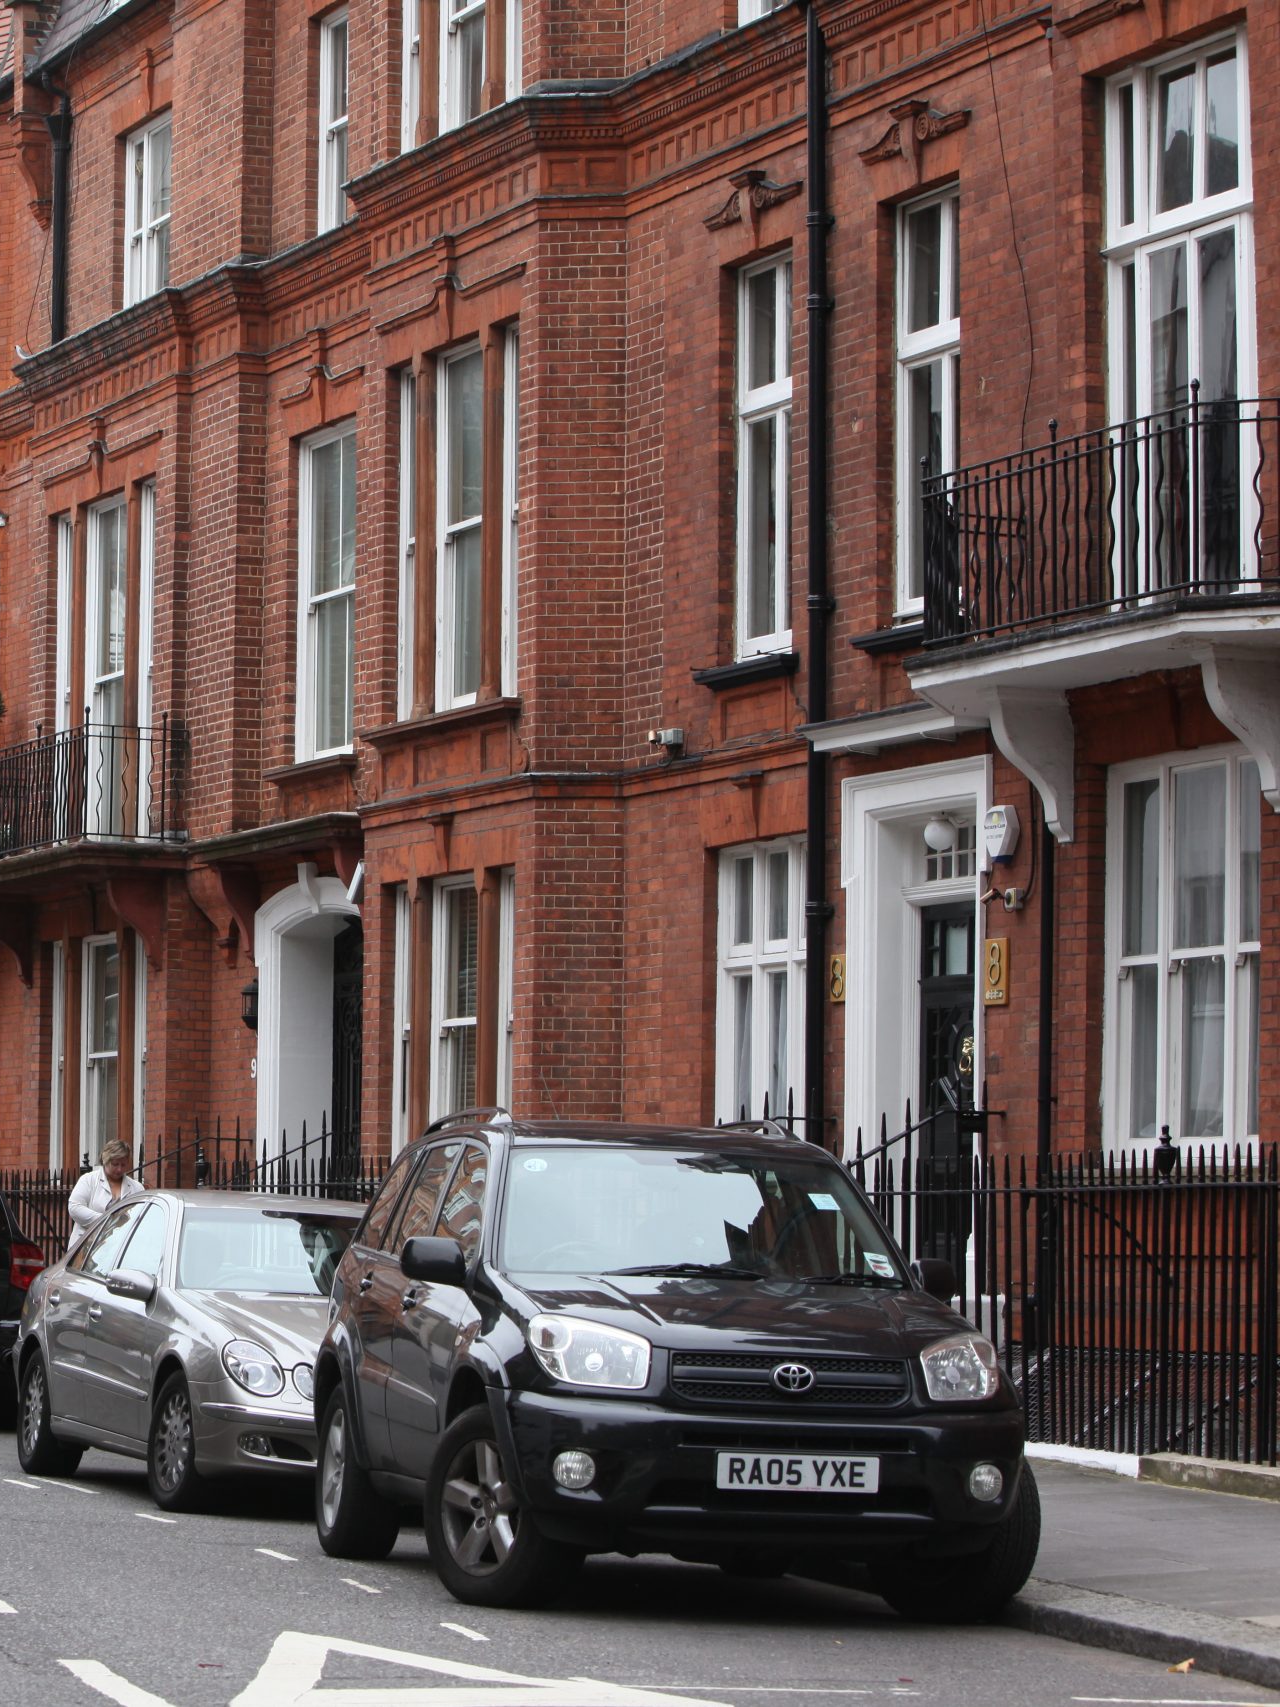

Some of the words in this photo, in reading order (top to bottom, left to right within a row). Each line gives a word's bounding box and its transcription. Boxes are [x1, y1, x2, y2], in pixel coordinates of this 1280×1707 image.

[831, 958, 843, 997] 8
[989, 943, 1001, 985] 8
[251, 1058, 256, 1078] 9
[728, 1457, 803, 1486] RA05
[812, 1460, 866, 1488] YXE
